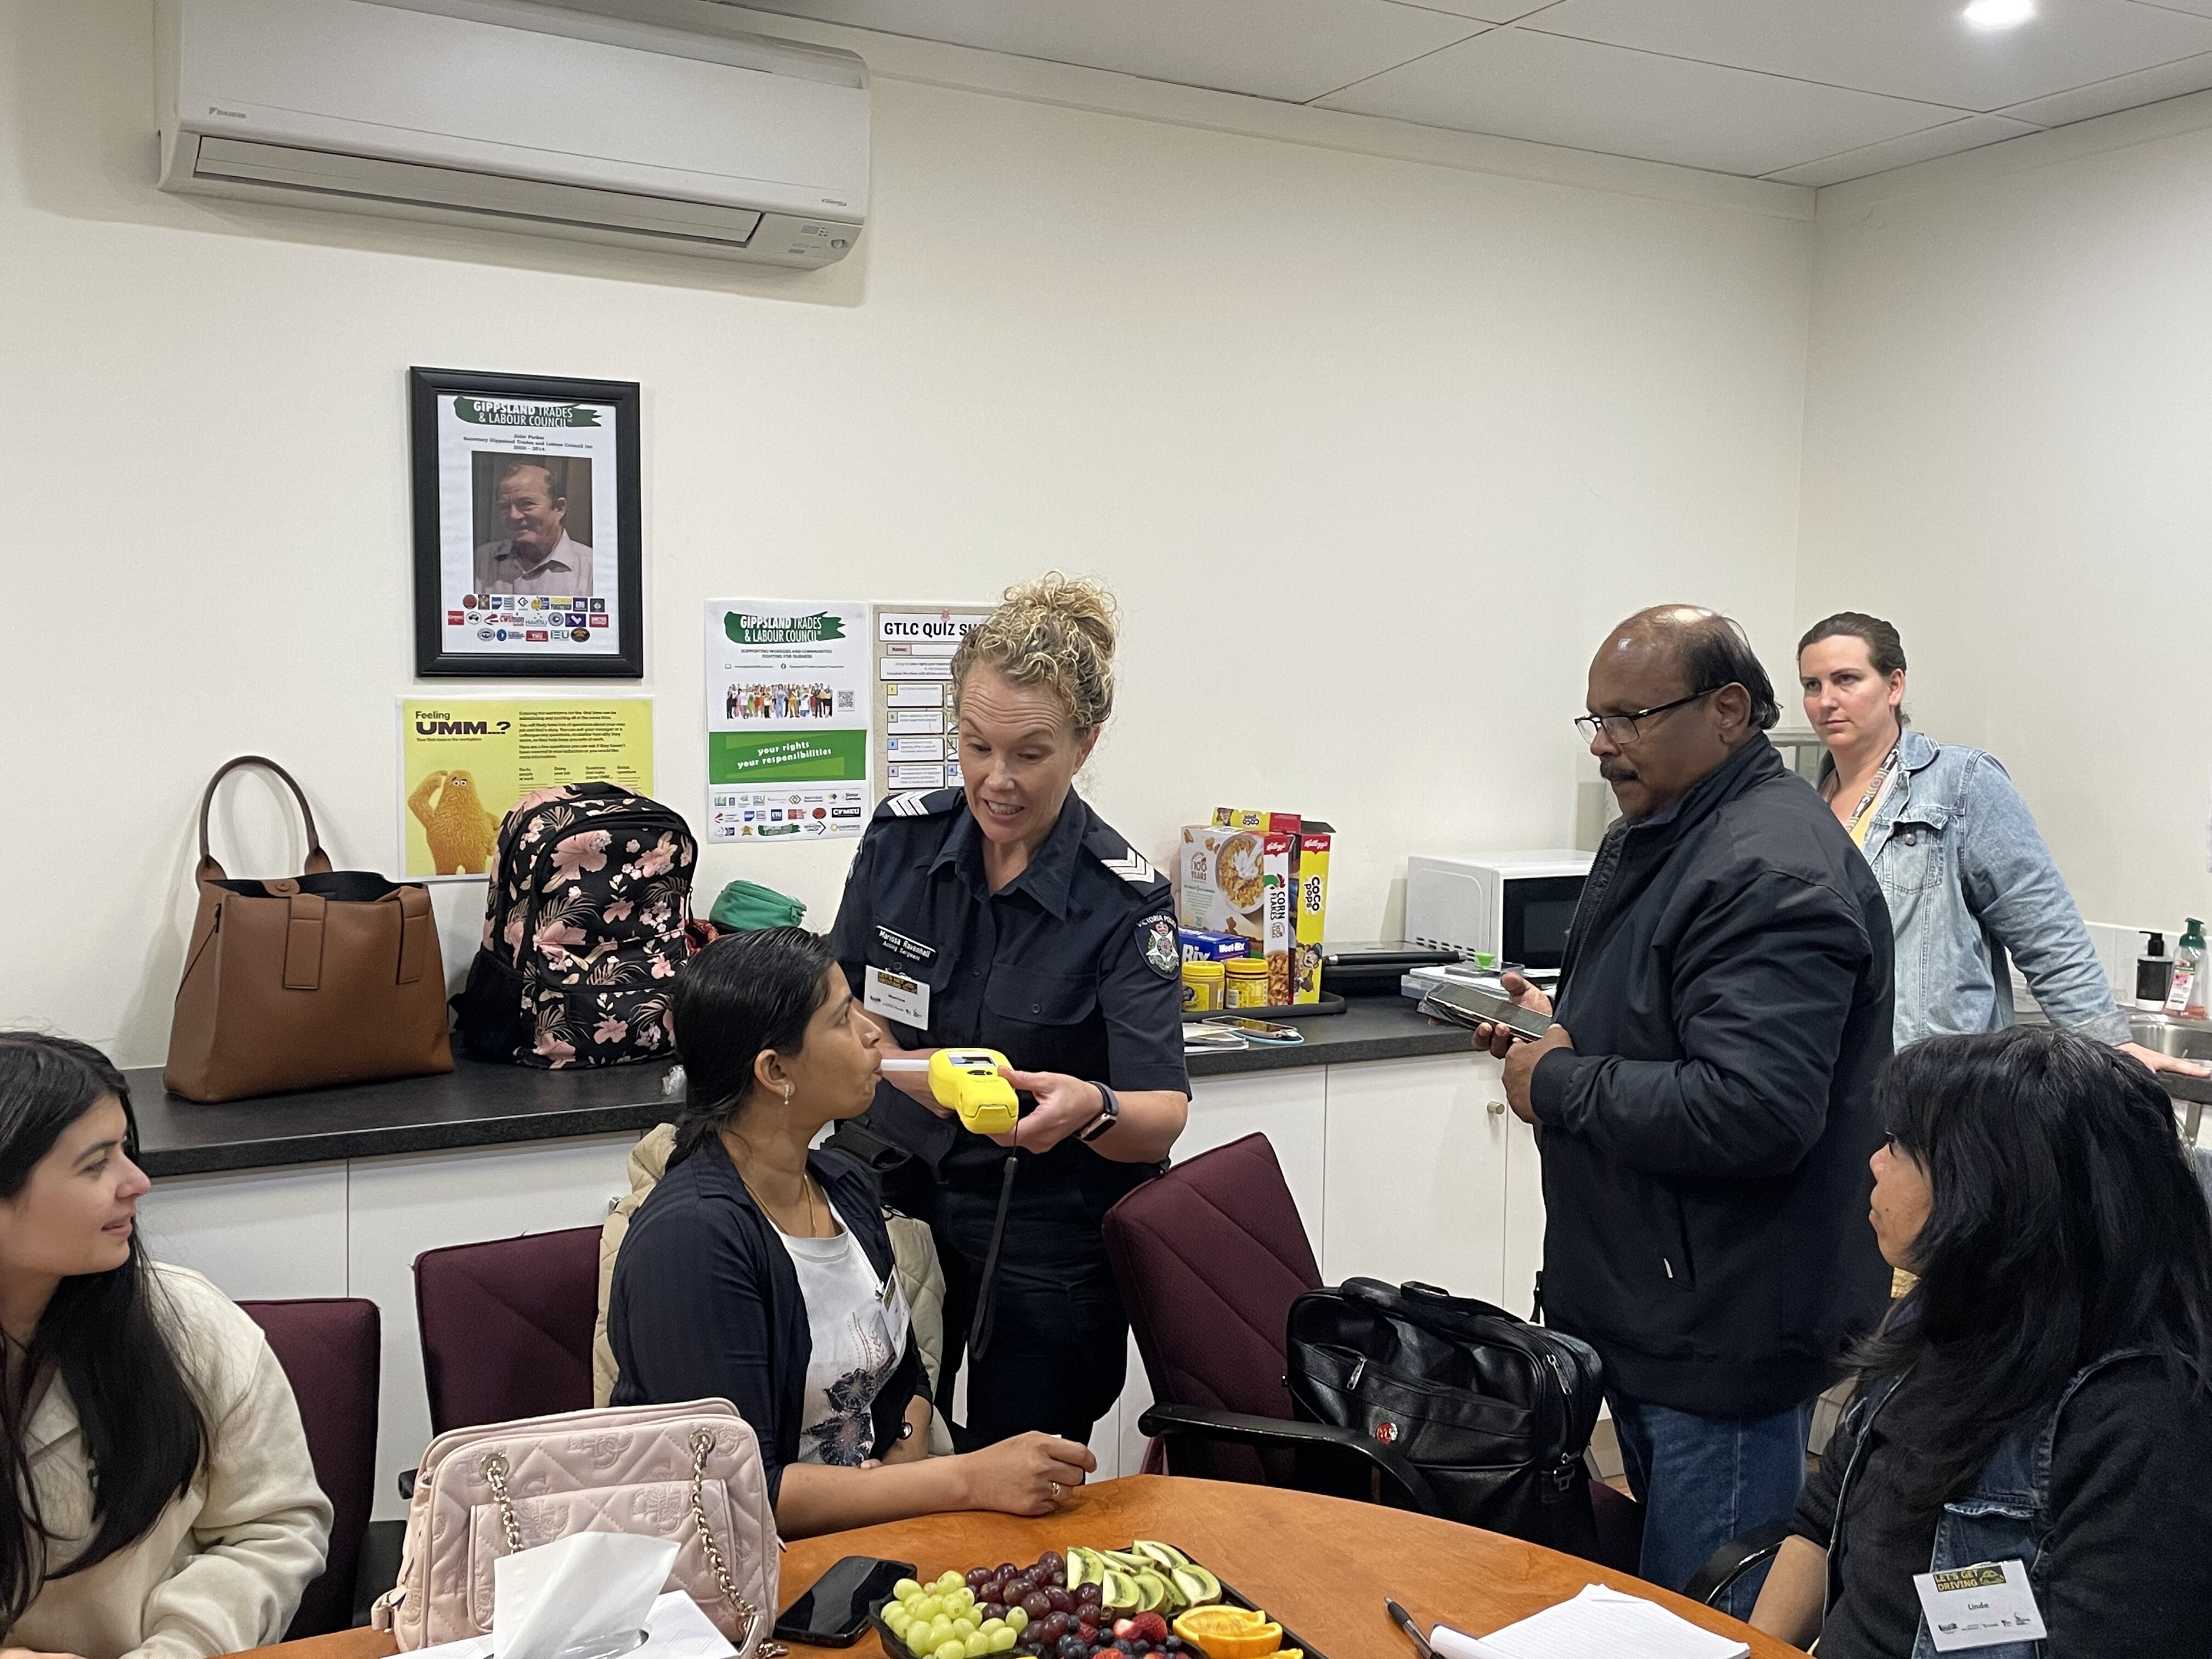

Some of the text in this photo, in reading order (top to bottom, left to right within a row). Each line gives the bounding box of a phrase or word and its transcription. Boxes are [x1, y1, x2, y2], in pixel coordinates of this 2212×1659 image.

[473, 401, 573, 418] GIPPSLAND TRADES
[479, 412, 567, 427] & LABOUR COUNCIL
[741, 616, 822, 629] GIPPSLAND TRADES
[744, 629, 817, 642] & LABOUR COUNCIL
[884, 623, 919, 635] GTLC
[923, 622, 955, 637] QUIZ
[415, 711, 450, 720] Feeling
[757, 742, 810, 757] your rights
[737, 748, 832, 770] your responsibilities
[833, 808, 860, 816] CFMEU
[1304, 839, 1328, 849] Kellogg's
[1193, 861, 1207, 872] 100
[1191, 871, 1206, 881] YEARS
[1277, 891, 1285, 919] CORN
[879, 930, 931, 958] Marissa Ravenhall
[882, 940, 921, 961] Acting Sergeant
[1218, 942, 1245, 953] Weet-Bix
[1935, 1569, 1979, 1583] LET'S GET
[1937, 1579, 1978, 1592] DRIVING
[1967, 1601, 1989, 1610] Linda
